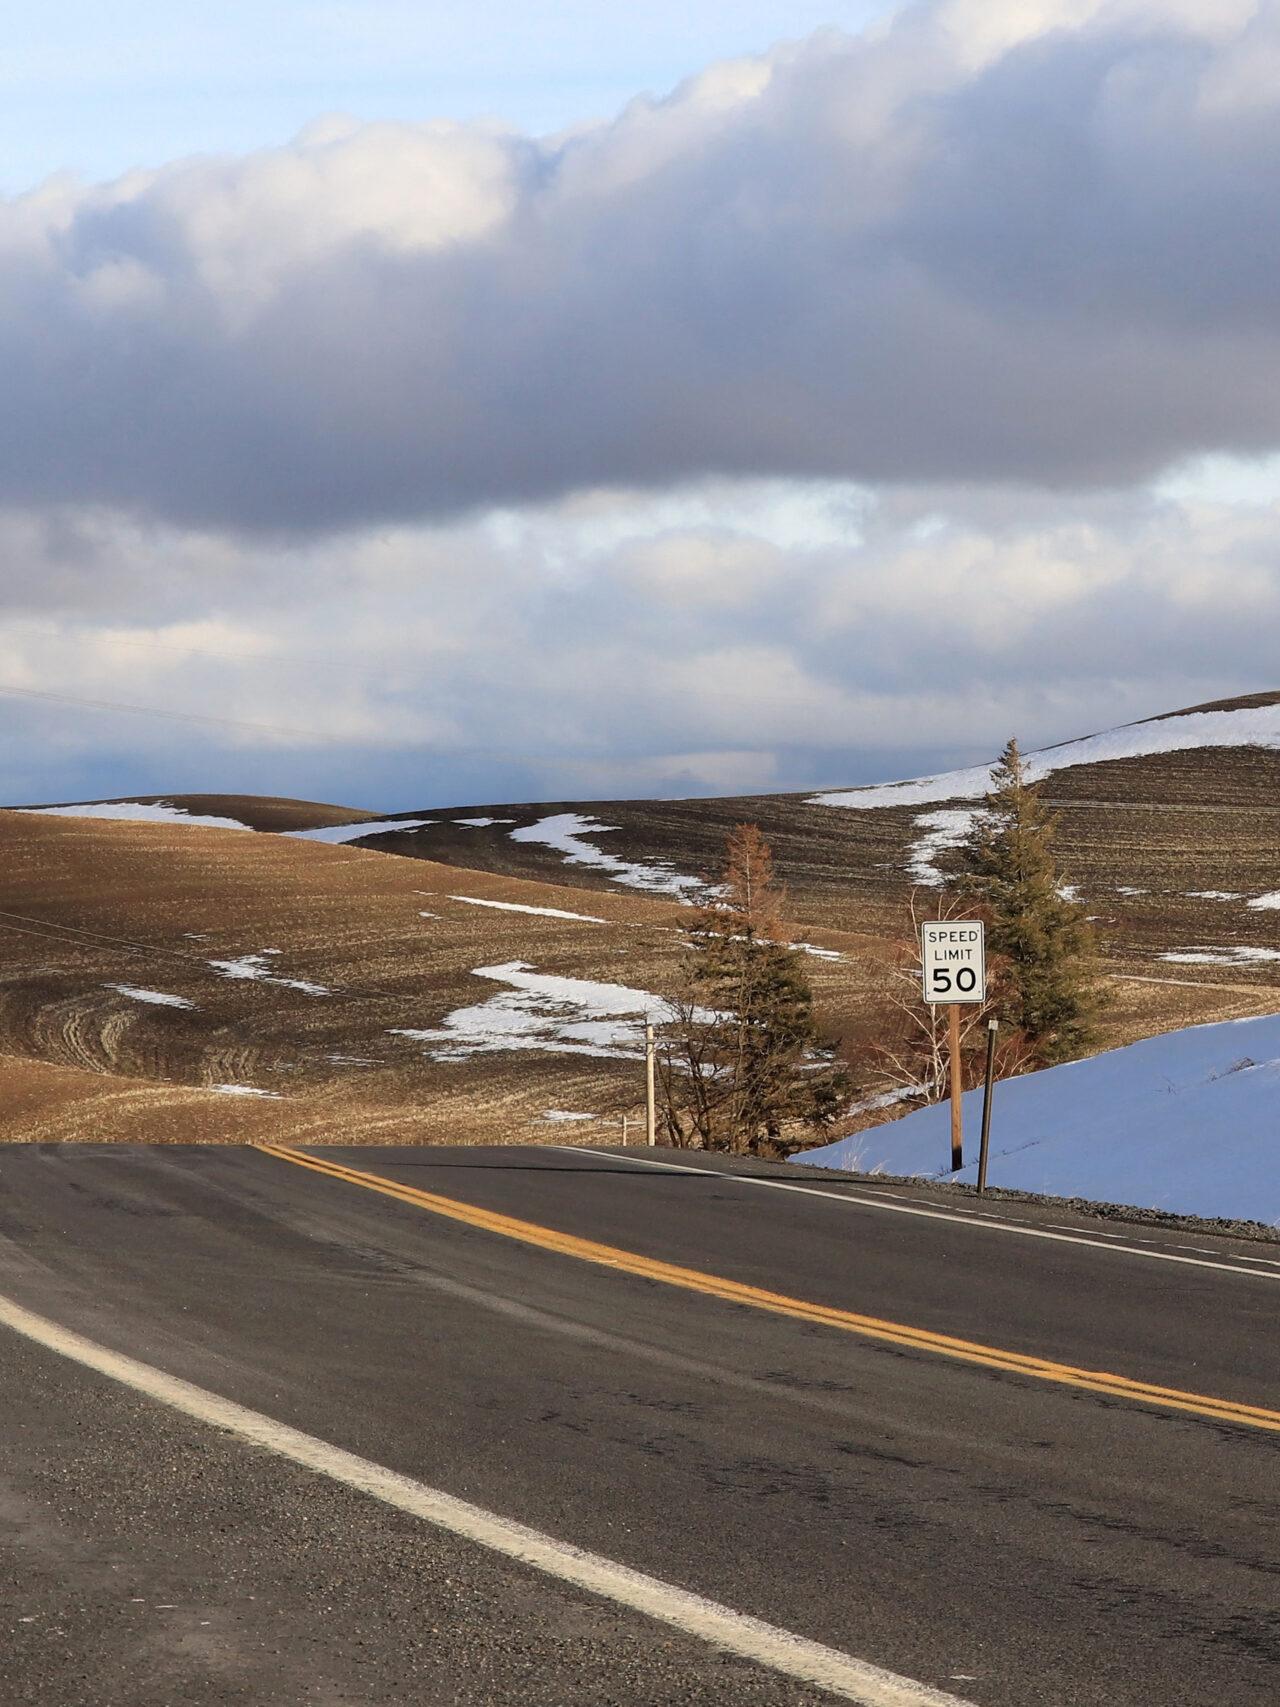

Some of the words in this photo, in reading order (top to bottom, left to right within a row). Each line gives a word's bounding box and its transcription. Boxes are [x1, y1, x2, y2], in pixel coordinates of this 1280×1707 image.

[929, 931, 978, 943] SPEED
[934, 949, 972, 960] LIMIT
[933, 967, 976, 993] 50
